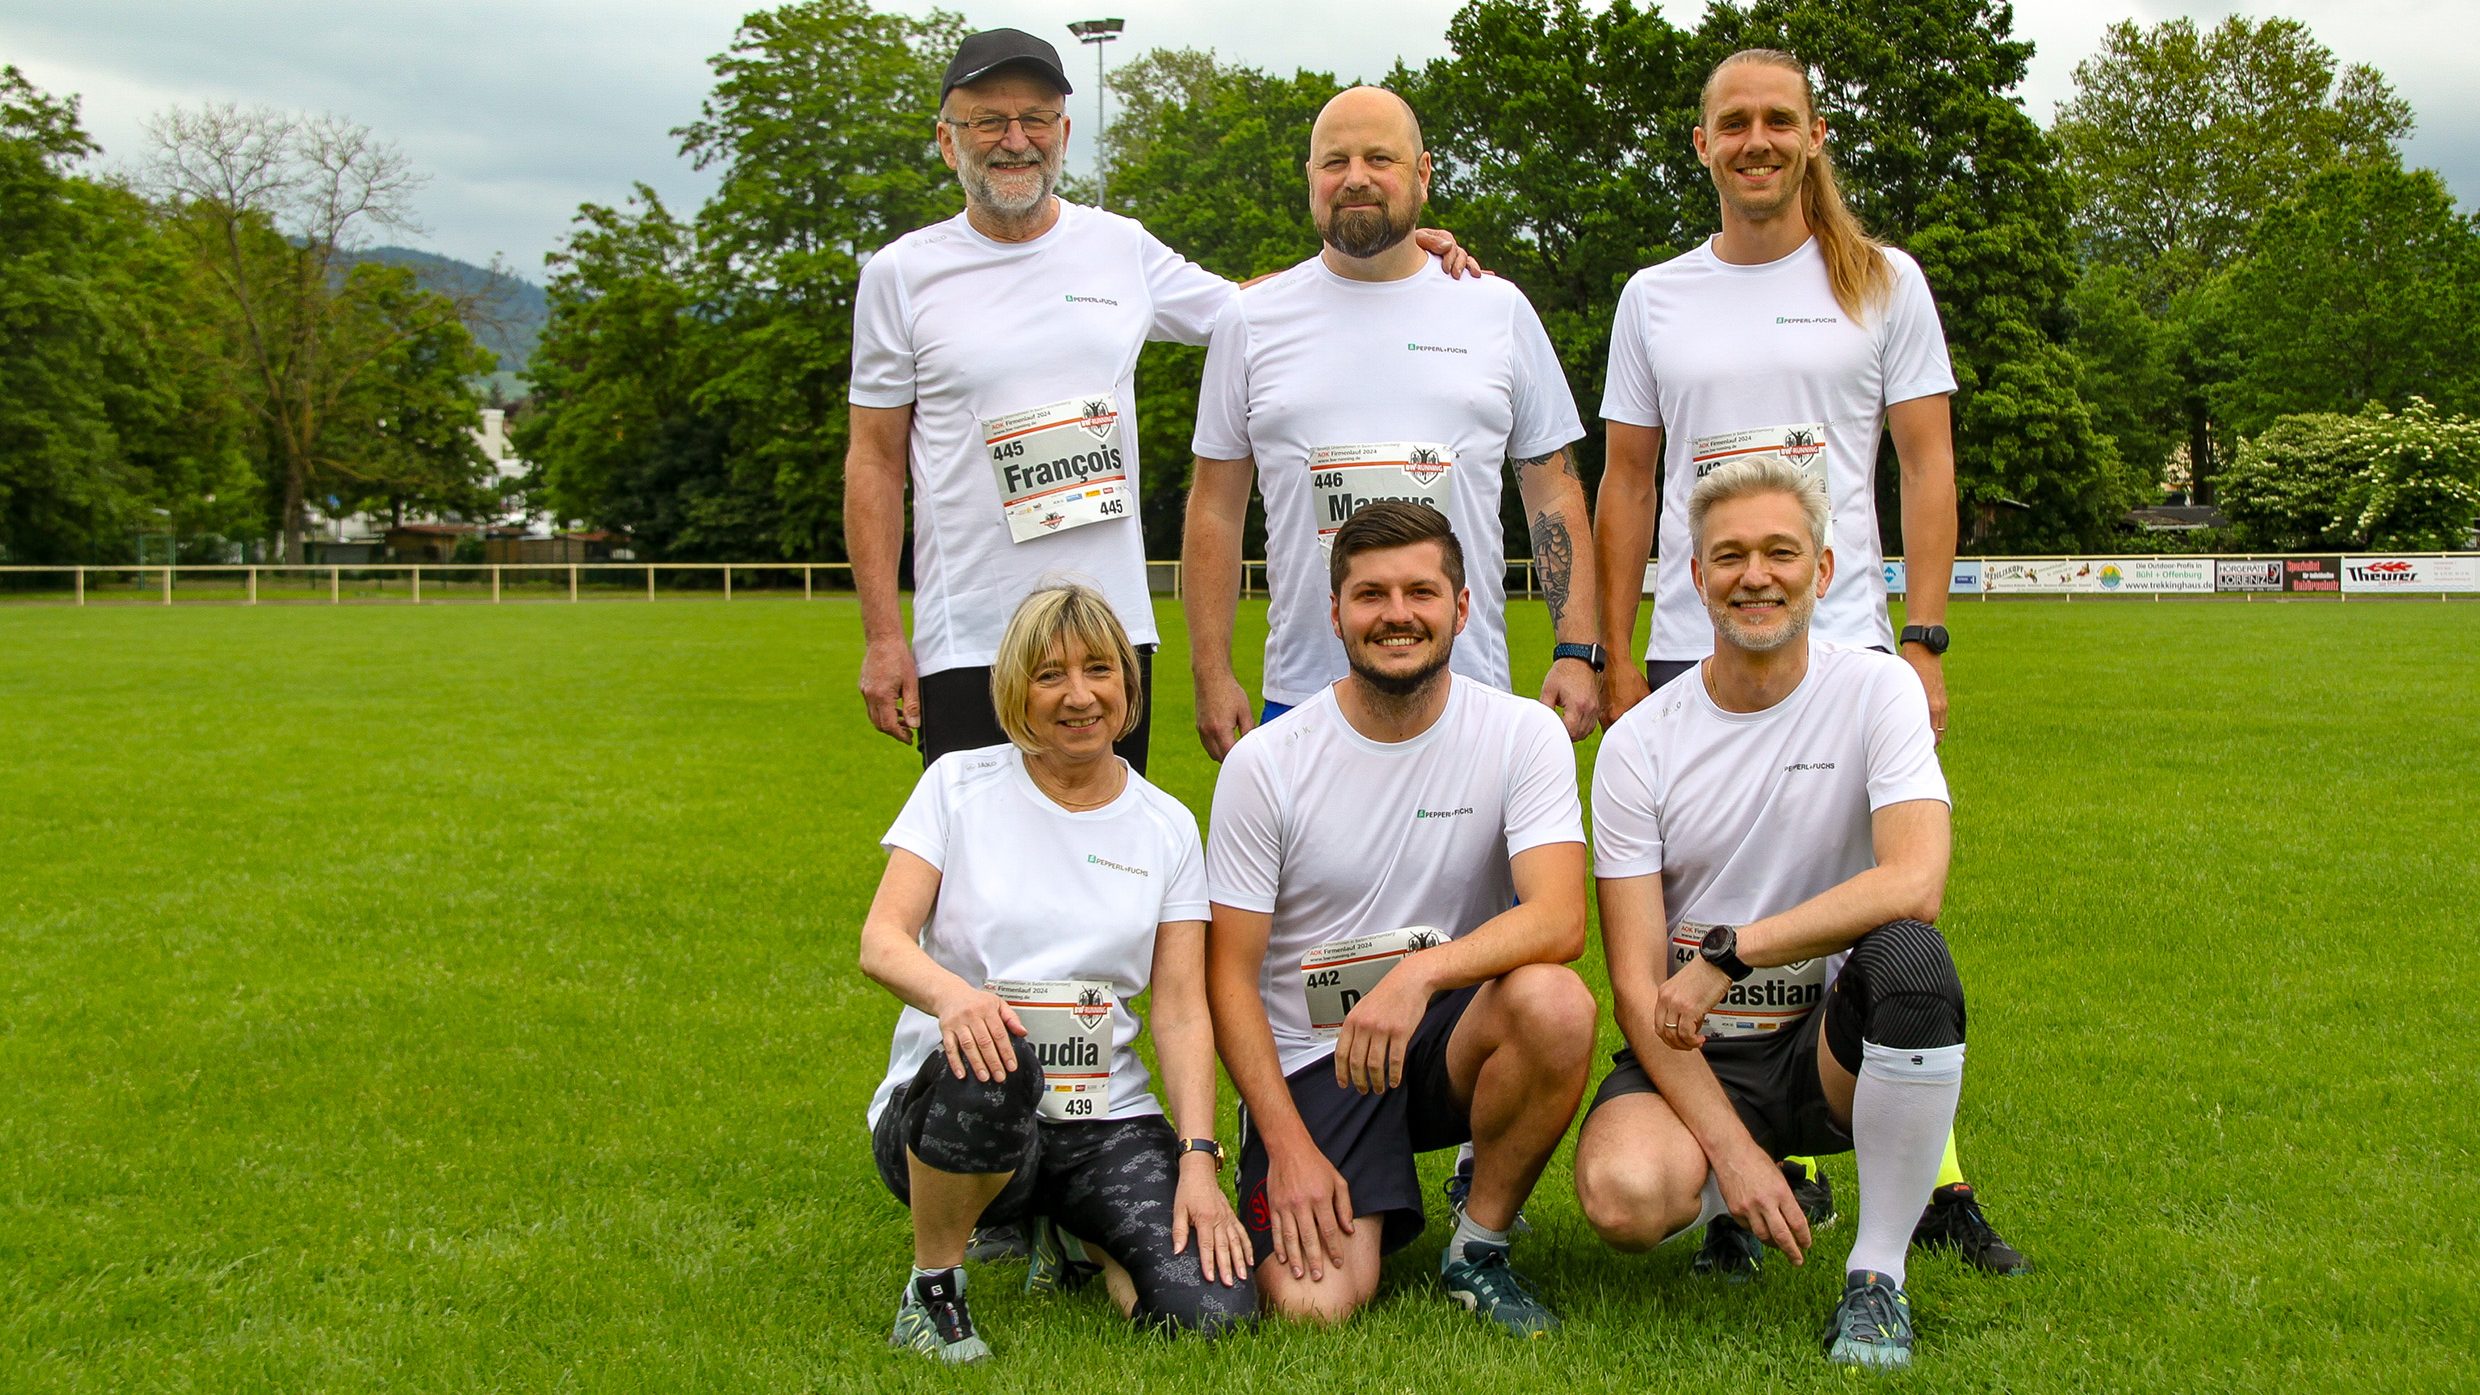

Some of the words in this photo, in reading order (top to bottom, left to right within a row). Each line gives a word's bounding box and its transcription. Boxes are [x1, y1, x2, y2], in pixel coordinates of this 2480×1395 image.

[991, 422, 1004, 430] AOK
[1005, 414, 1036, 426] Firmenlauf
[1037, 410, 1051, 419] 2024
[1710, 437, 1737, 447] Firmenlauf
[993, 441, 1025, 461] 445
[1331, 449, 1362, 457] Firmenlauf
[1004, 444, 1122, 493] François
[1314, 472, 1343, 489] 446
[1100, 499, 1123, 515] 445
[2136, 570, 2153, 578] Bühl
[2162, 570, 2203, 580] Offenburg
[2219, 575, 2267, 586] LORENZ
[2345, 566, 2418, 582] Theurer
[2125, 581, 2214, 590] www.trekkinghaus.de
[1324, 944, 1356, 954] Firmenlauf
[1357, 942, 1373, 950] 2024
[1307, 970, 1341, 989] 442
[998, 985, 1032, 994] Firmenlauf
[1065, 1098, 1093, 1116] 439
